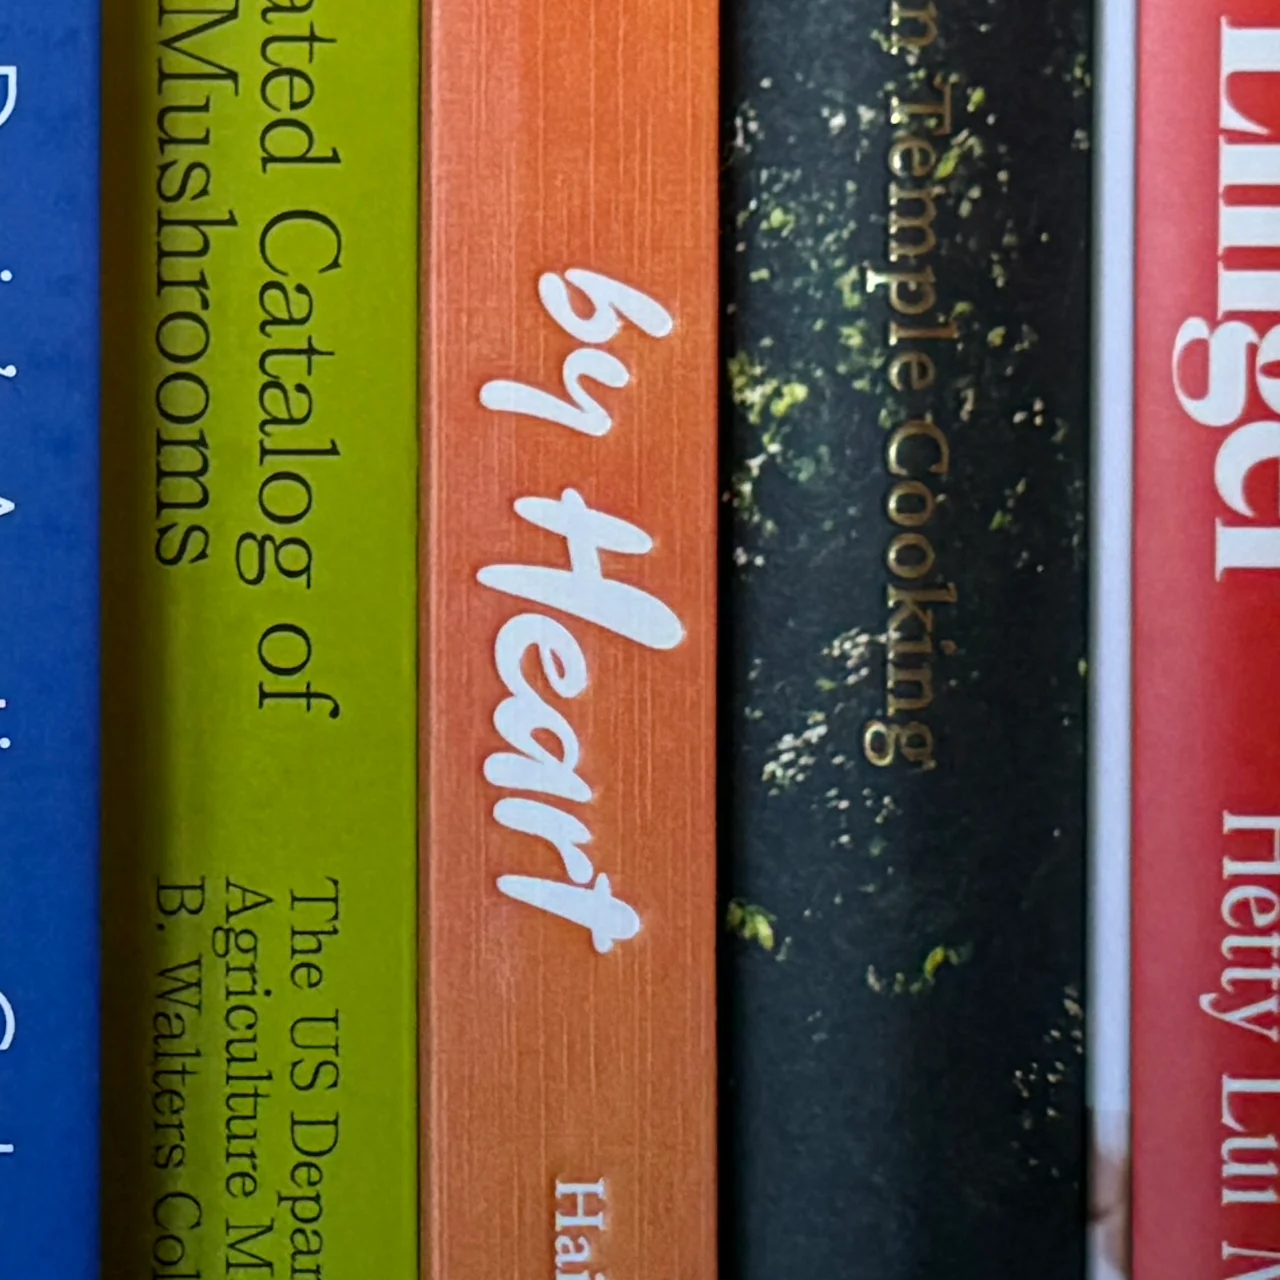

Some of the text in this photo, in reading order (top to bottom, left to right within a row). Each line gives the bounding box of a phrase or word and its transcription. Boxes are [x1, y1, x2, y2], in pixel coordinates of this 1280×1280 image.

[863, 81, 955, 391] Temple
[236, 208, 343, 588] Catalog
[257, 621, 341, 721] of
[477, 268, 687, 955] by Heart
[863, 416, 958, 767] Cooking
[155, 876, 206, 932] B.
[288, 876, 341, 992] The
[151, 957, 204, 1170] Walters
[212, 876, 274, 1200] Agriculture
[288, 1008, 341, 1096] US
